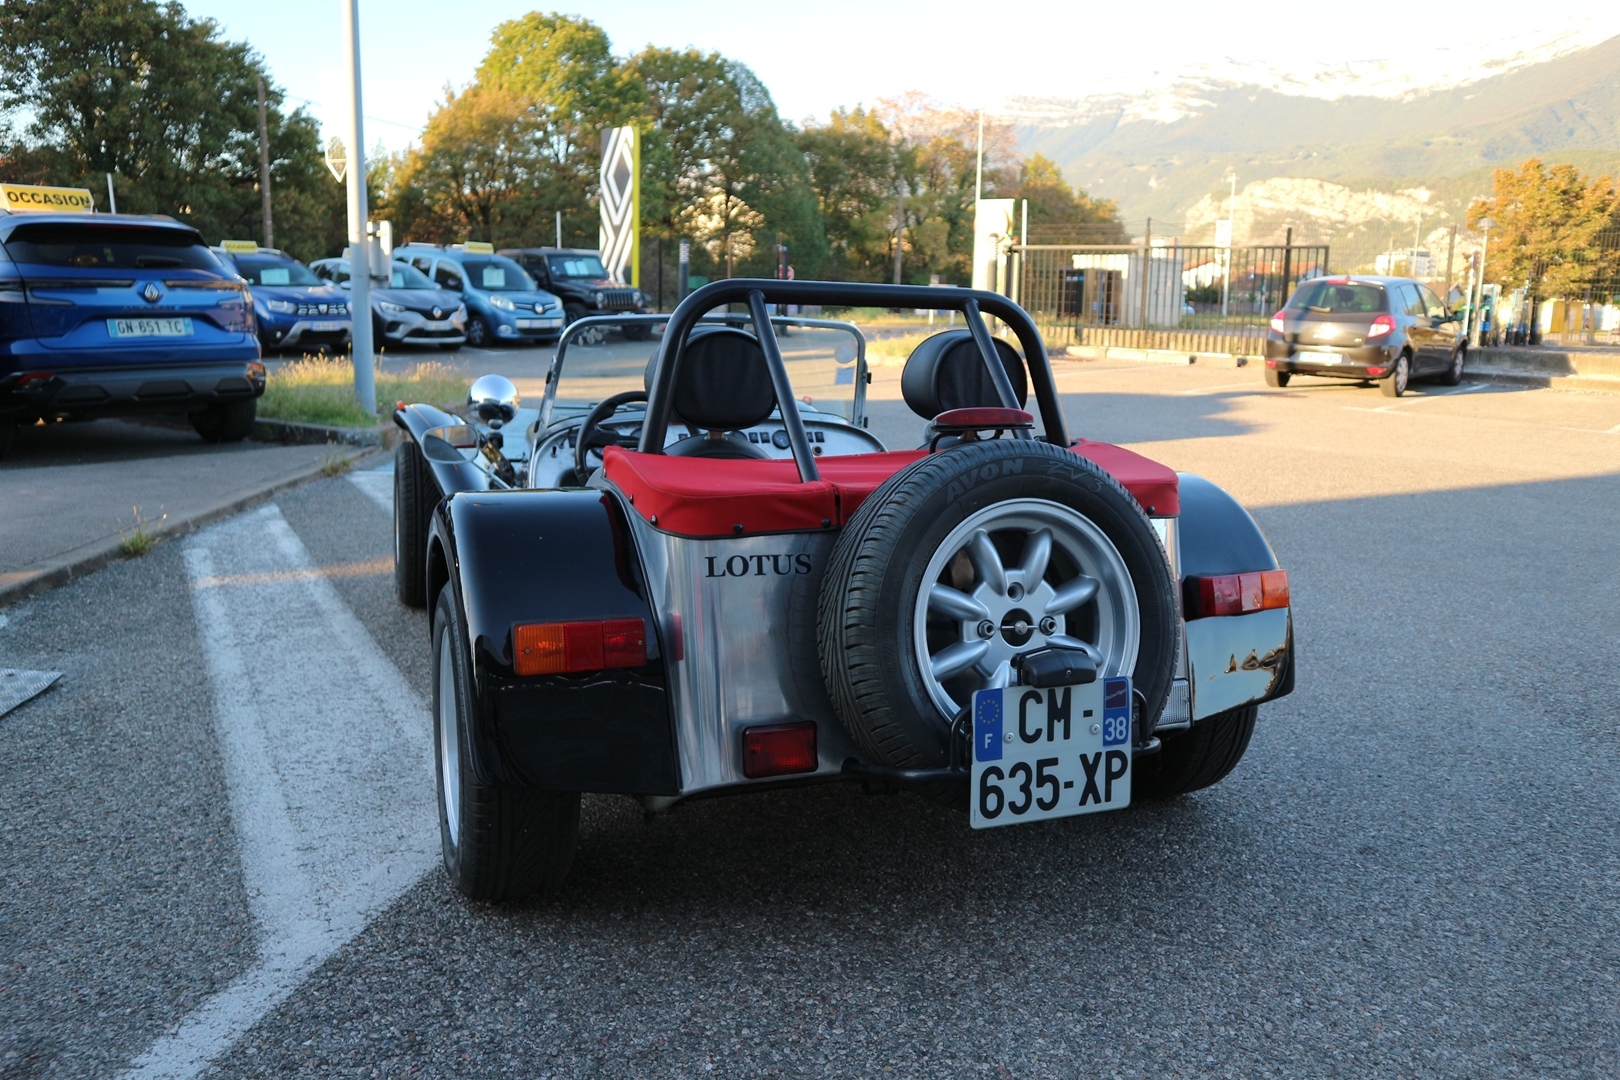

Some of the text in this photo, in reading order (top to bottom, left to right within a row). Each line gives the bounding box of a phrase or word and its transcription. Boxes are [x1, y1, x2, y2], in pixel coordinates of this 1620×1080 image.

[7, 191, 89, 206] OCCASION
[945, 458, 1024, 504] AVON
[704, 553, 812, 578] LOTUS
[984, 733, 993, 749] F
[1104, 716, 1127, 741] 38
[979, 750, 1128, 819] 635-XP
